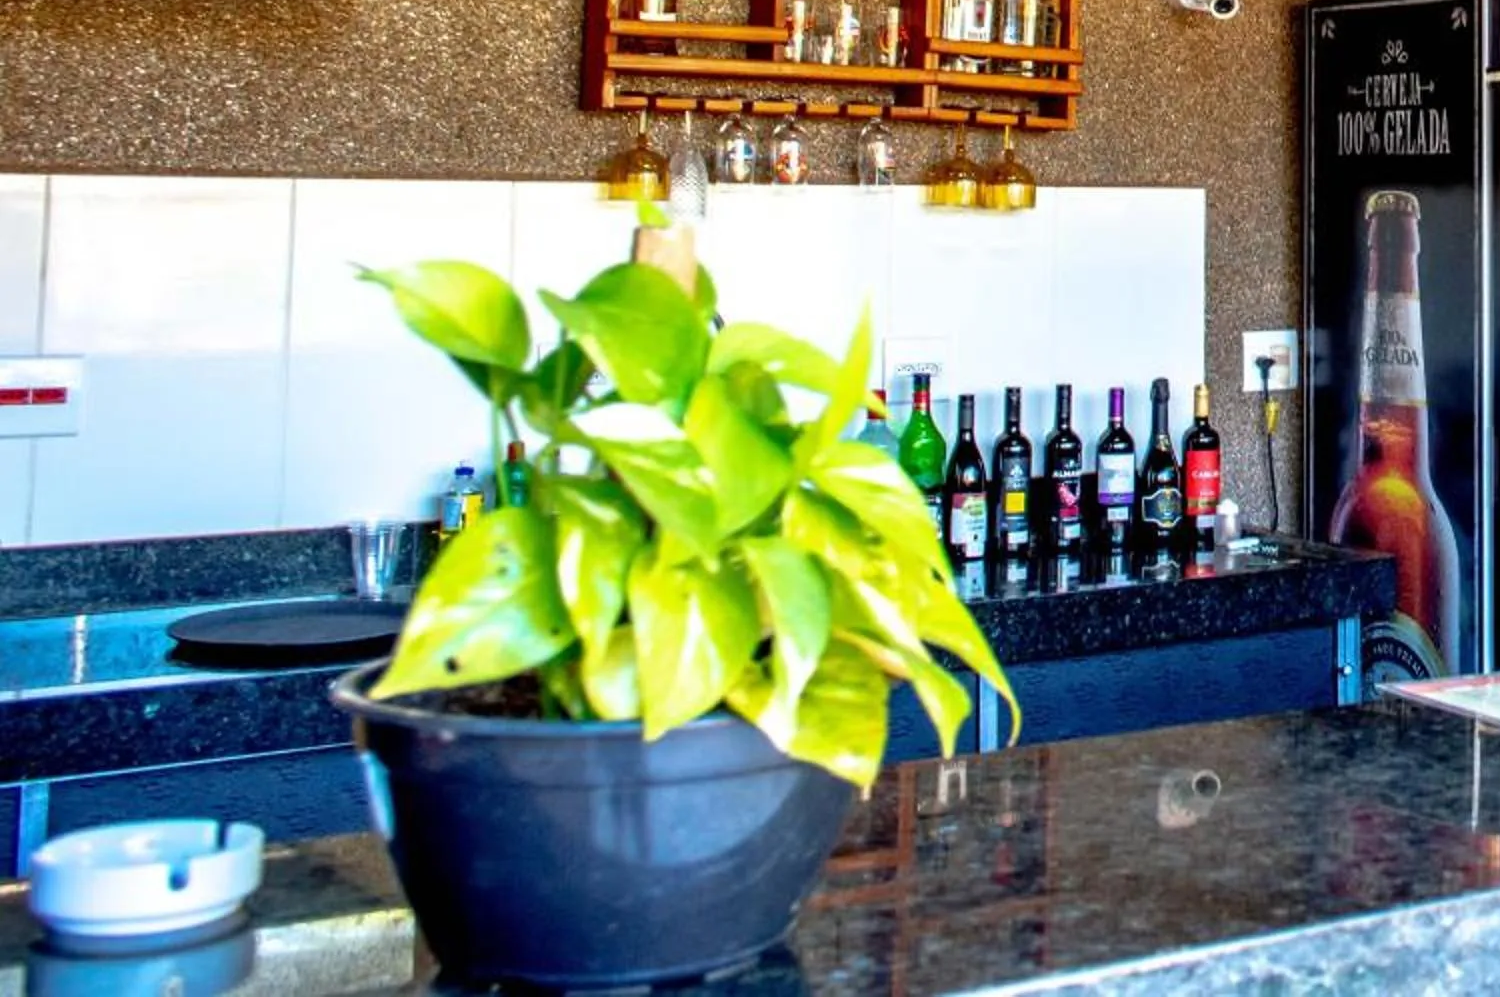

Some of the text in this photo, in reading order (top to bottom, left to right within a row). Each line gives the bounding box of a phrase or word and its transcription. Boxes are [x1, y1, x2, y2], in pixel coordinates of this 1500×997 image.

[1366, 72, 1422, 107] CERVEJA
[1338, 107, 1451, 155] 100% GELADA
